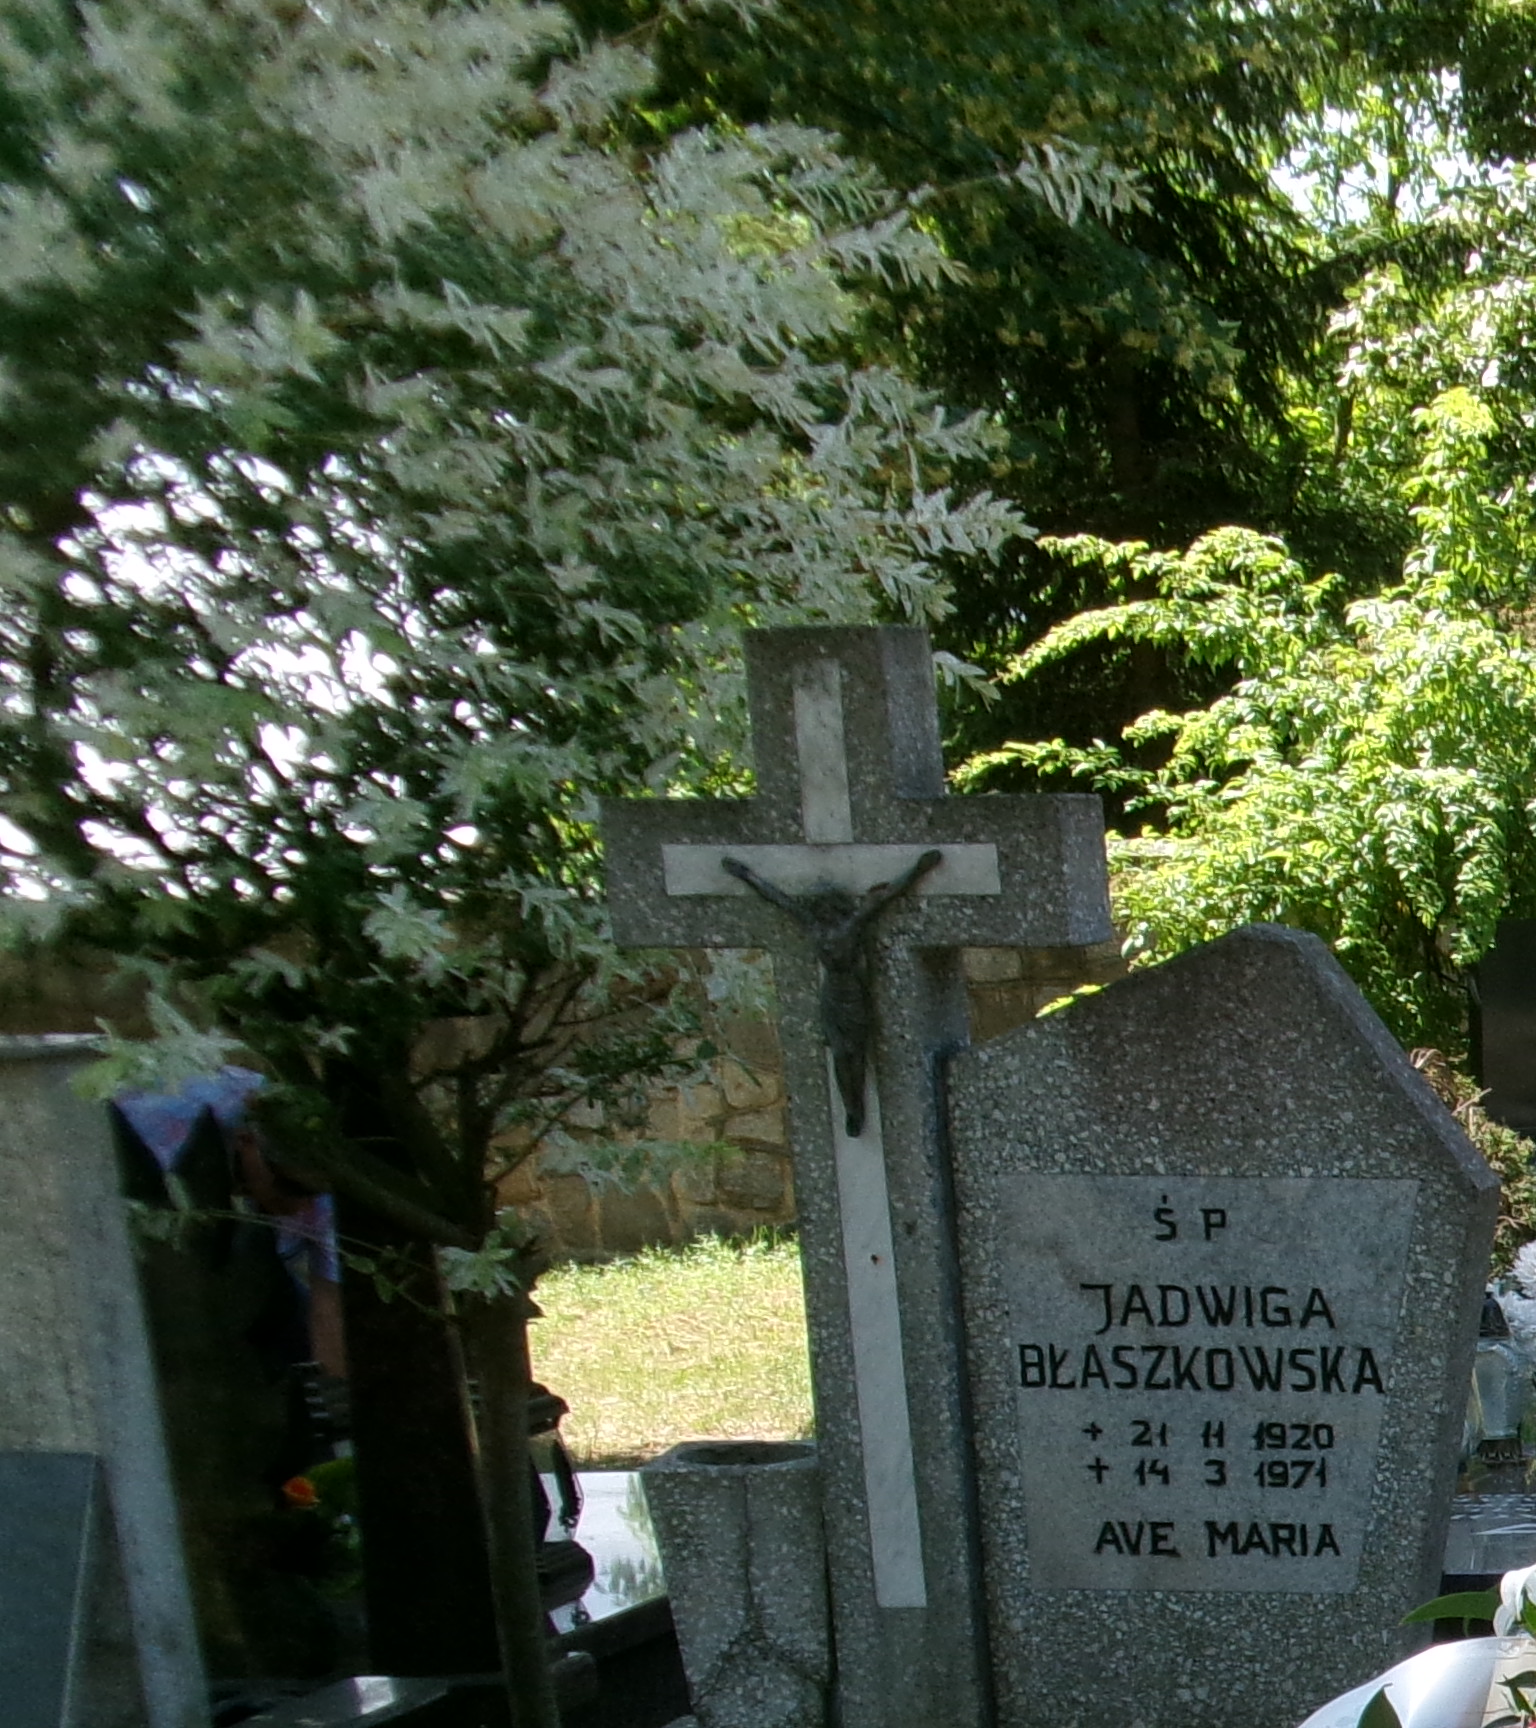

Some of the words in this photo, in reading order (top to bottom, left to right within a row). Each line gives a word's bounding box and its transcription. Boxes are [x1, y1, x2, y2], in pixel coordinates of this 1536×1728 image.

[1080, 1283, 1337, 1335] JADWIGA
[1018, 1342, 1387, 1395] BŁASZKOWSKA
[1130, 1420, 1168, 1449] 21
[1253, 1420, 1336, 1451] 1920
[1134, 1458, 1171, 1487] 14
[1204, 1460, 1228, 1488] 3
[1254, 1456, 1327, 1489] 1971
[1094, 1521, 1181, 1559] AVE
[1206, 1521, 1341, 1559] MARIA
